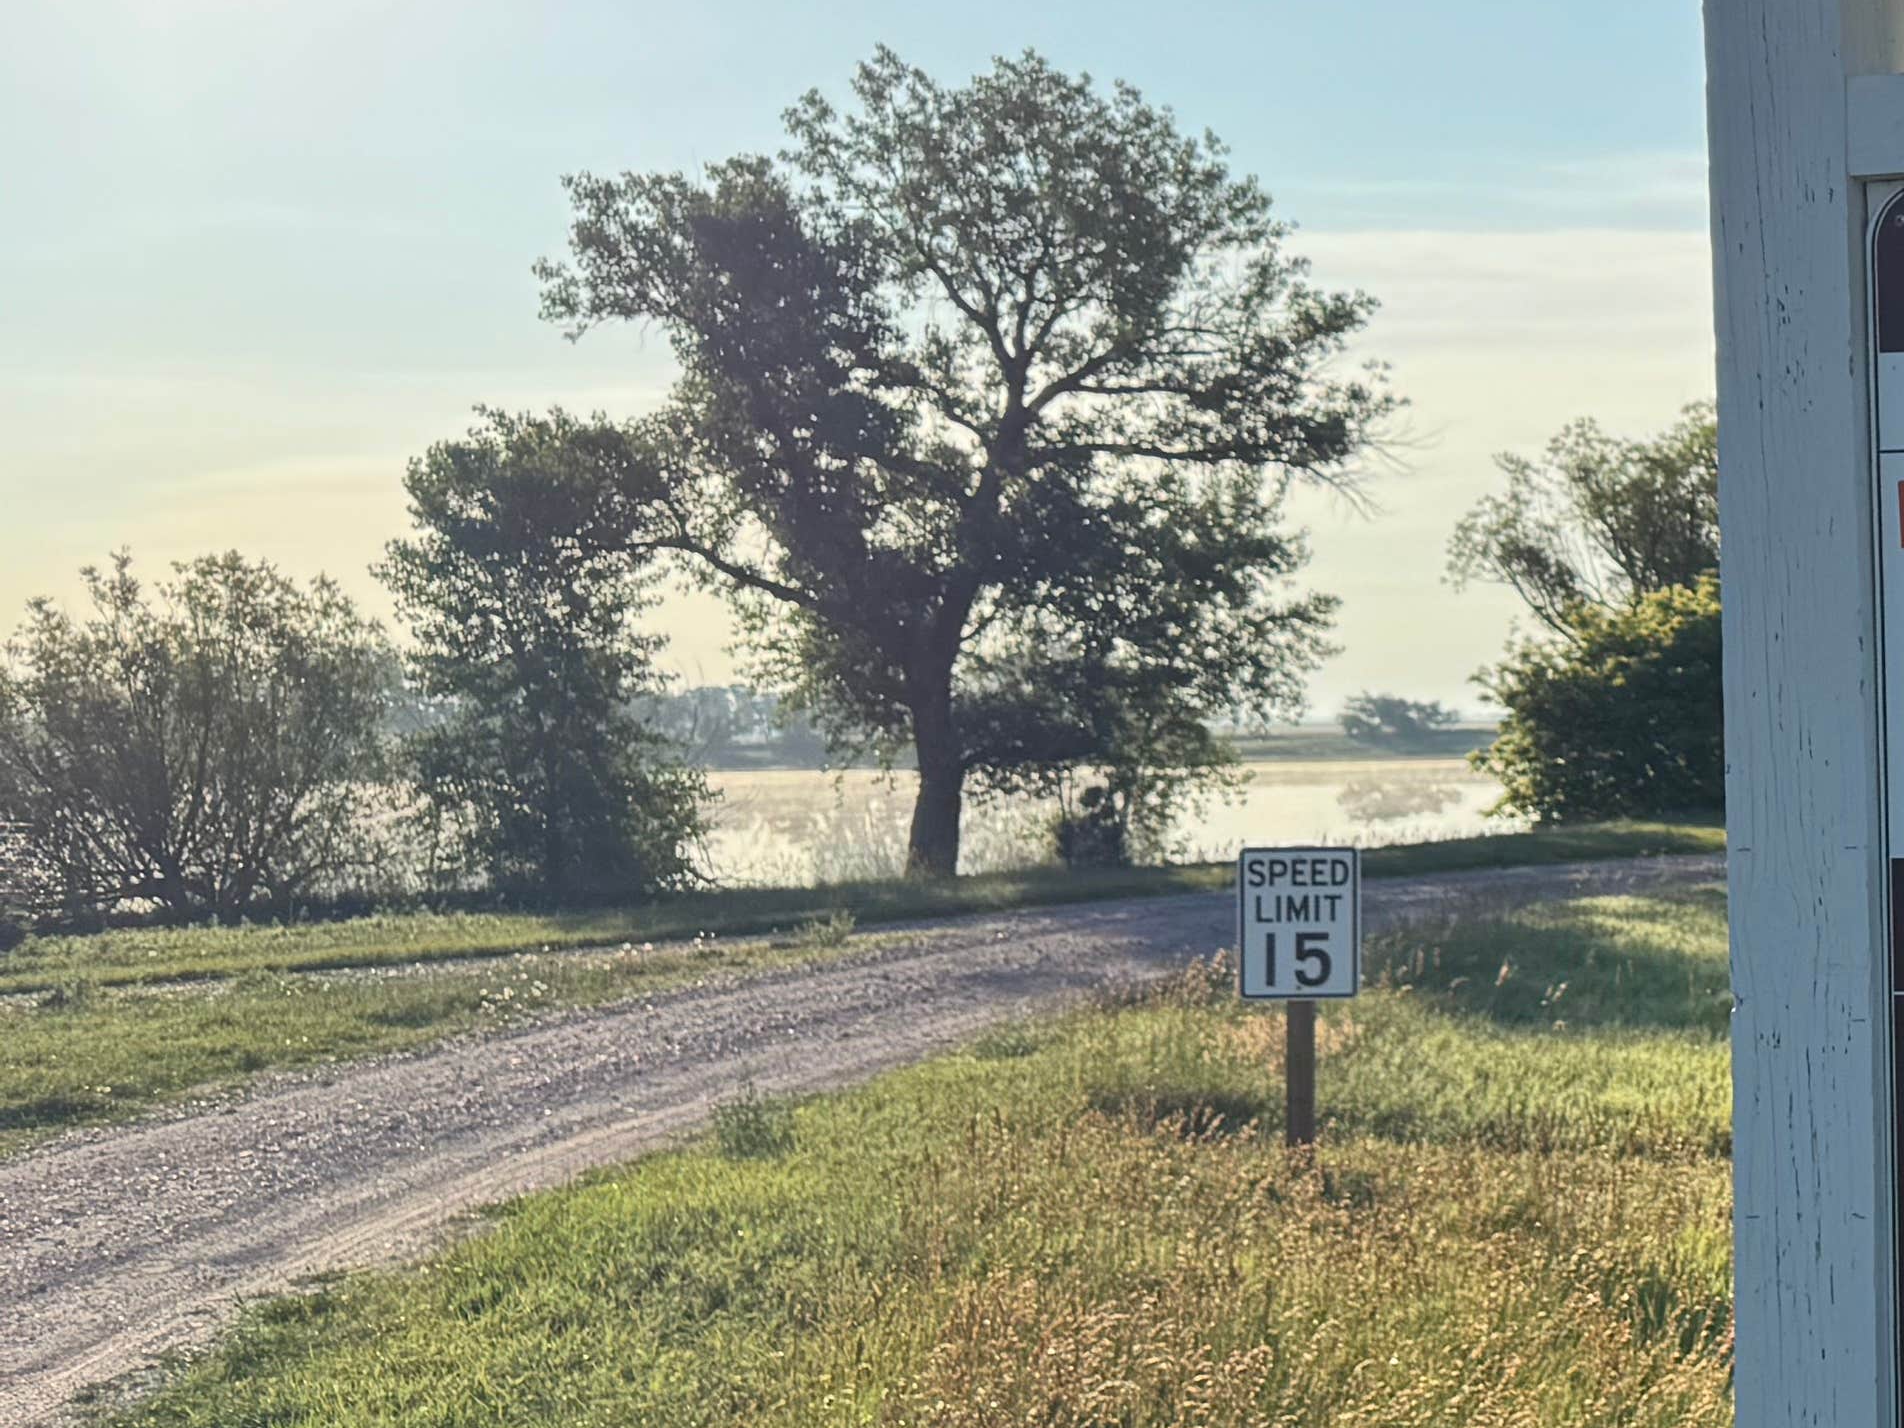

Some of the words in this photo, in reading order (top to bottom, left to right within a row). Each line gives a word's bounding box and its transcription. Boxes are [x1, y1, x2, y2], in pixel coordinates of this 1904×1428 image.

[1247, 857, 1350, 889] SPEED
[1256, 895, 1341, 922] LIMIT
[1266, 932, 1330, 986] 15
